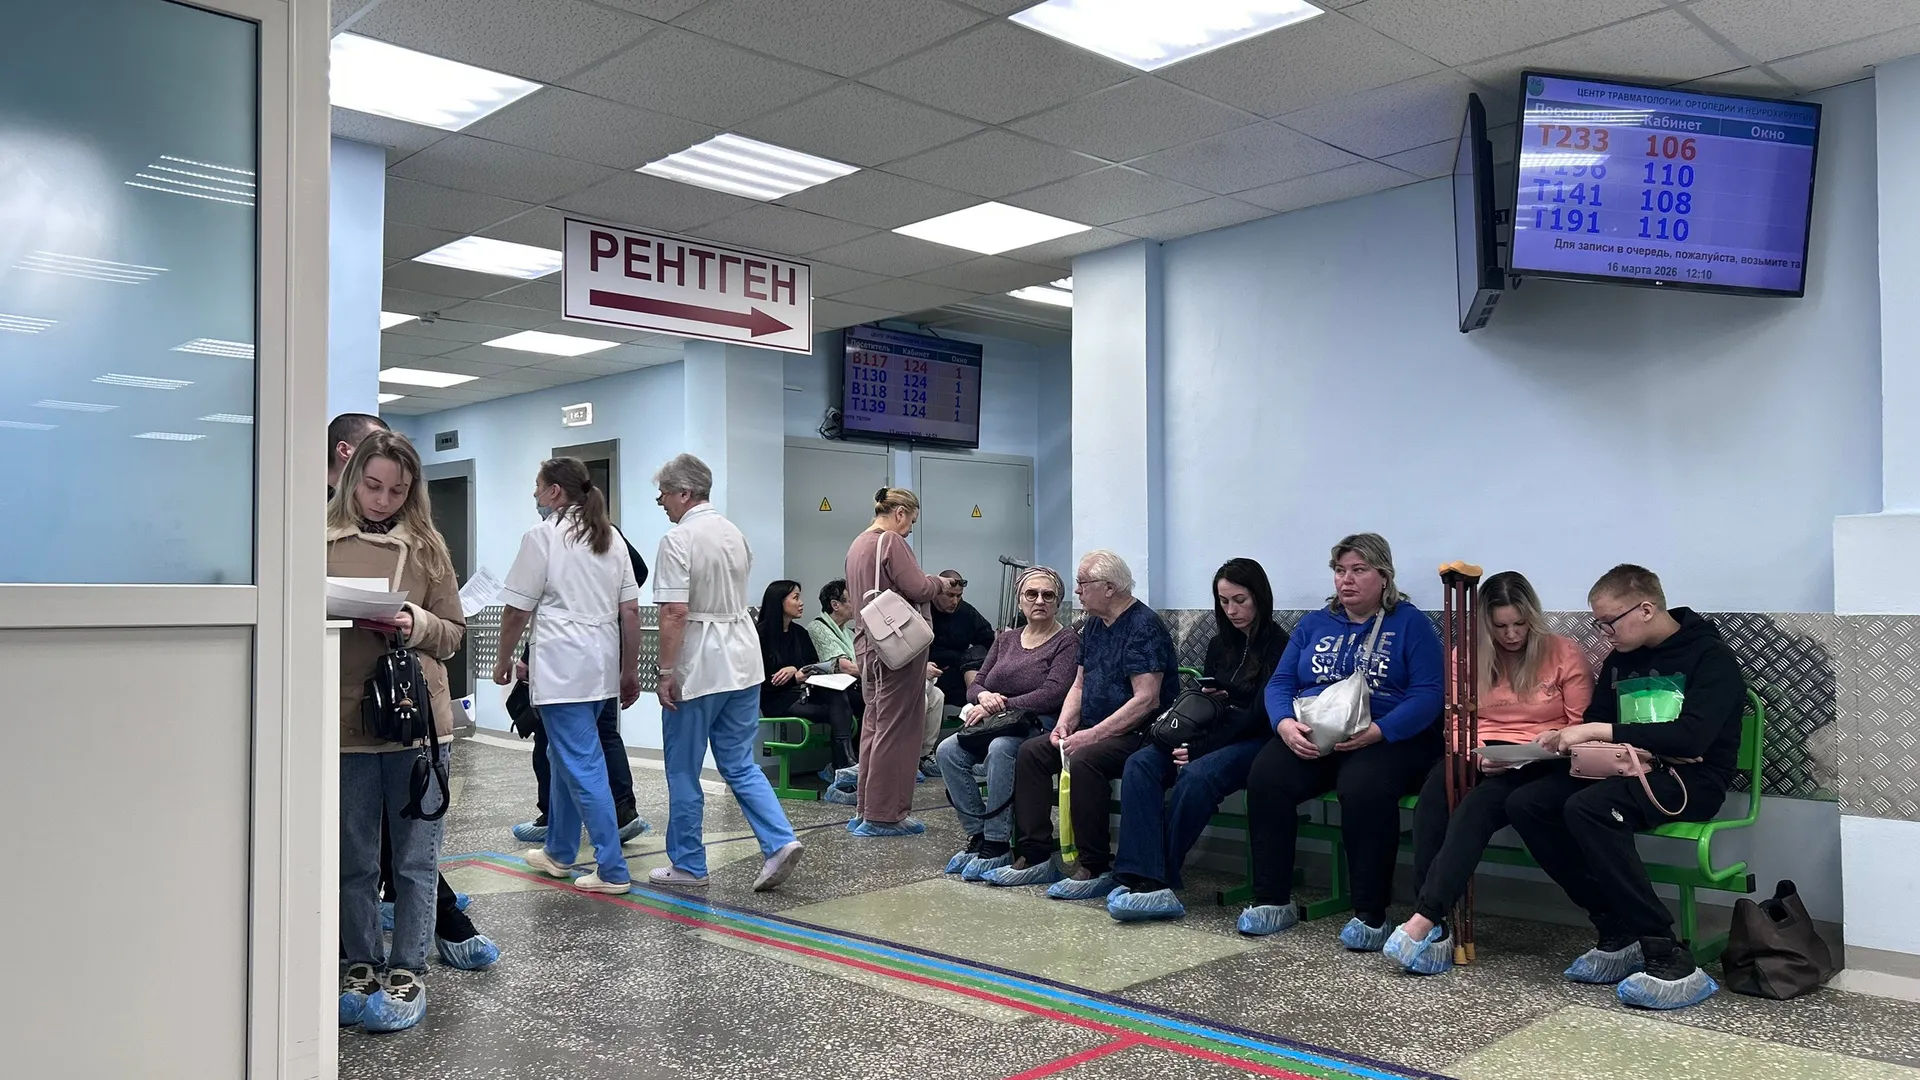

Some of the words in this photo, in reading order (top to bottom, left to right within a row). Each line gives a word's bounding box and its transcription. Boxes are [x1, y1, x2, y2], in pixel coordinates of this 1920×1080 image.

[1577, 88, 1605, 98] ЦЕНТР
[1608, 91, 1683, 107] ТРАВМАТОЛОГИИ,
[1685, 99, 1736, 113] ОРТОПЕДИИ
[1737, 106, 1744, 114] И
[1644, 114, 1702, 131] Кабинет
[1751, 126, 1785, 140] Окно
[1538, 124, 1609, 152] Т233
[1646, 135, 1696, 161] 106
[1643, 162, 1694, 188] 110
[1533, 178, 1602, 207] Т141
[1641, 189, 1691, 215] 108
[1531, 206, 1600, 234] Т191
[1638, 216, 1689, 241] 110
[1554, 238, 1575, 250] Для
[1578, 242, 1614, 253] записи
[1617, 246, 1624, 254] в
[1626, 246, 1672, 259] очередь,
[1675, 250, 1738, 264] пожалуйста,
[1741, 256, 1788, 268] возьмите
[590, 230, 796, 306] РЕНТГЕН
[1607, 262, 1618, 272] 16
[1621, 265, 1651, 276] марта
[1654, 265, 1677, 277] 2026
[1686, 268, 1712, 280] 12:10
[902, 347, 930, 359] Кабинет
[951, 355, 967, 364] Окно
[904, 358, 928, 374] 124
[956, 367, 962, 379] 1
[852, 366, 887, 383] Т130
[903, 374, 927, 389] 124
[955, 381, 961, 394] 1
[851, 381, 887, 398] В118
[903, 389, 927, 403] 124
[955, 396, 960, 408] 1
[851, 396, 886, 413] Т139
[902, 403, 926, 418] 124
[954, 410, 959, 422] 1
